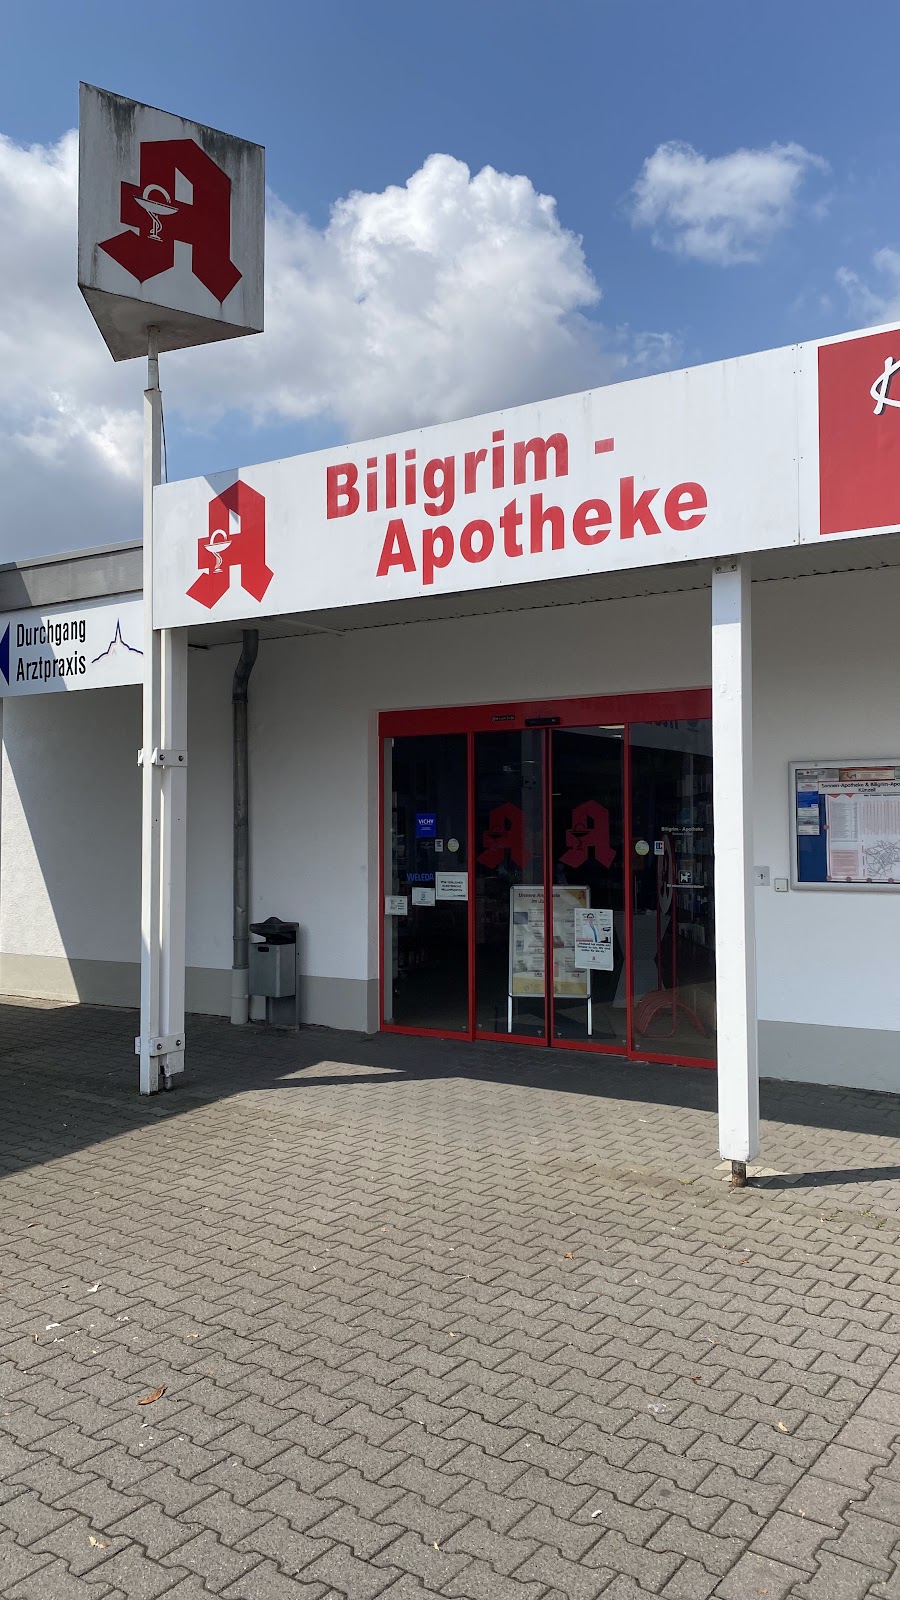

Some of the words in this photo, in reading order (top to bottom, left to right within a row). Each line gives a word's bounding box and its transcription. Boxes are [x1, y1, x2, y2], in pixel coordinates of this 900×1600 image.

[326, 431, 569, 519] Biligrim
[376, 477, 708, 585] Apotheke
[16, 619, 86, 647] Durchgang
[16, 651, 86, 682] Arztpraxis
[406, 872, 435, 882] WELEDA
